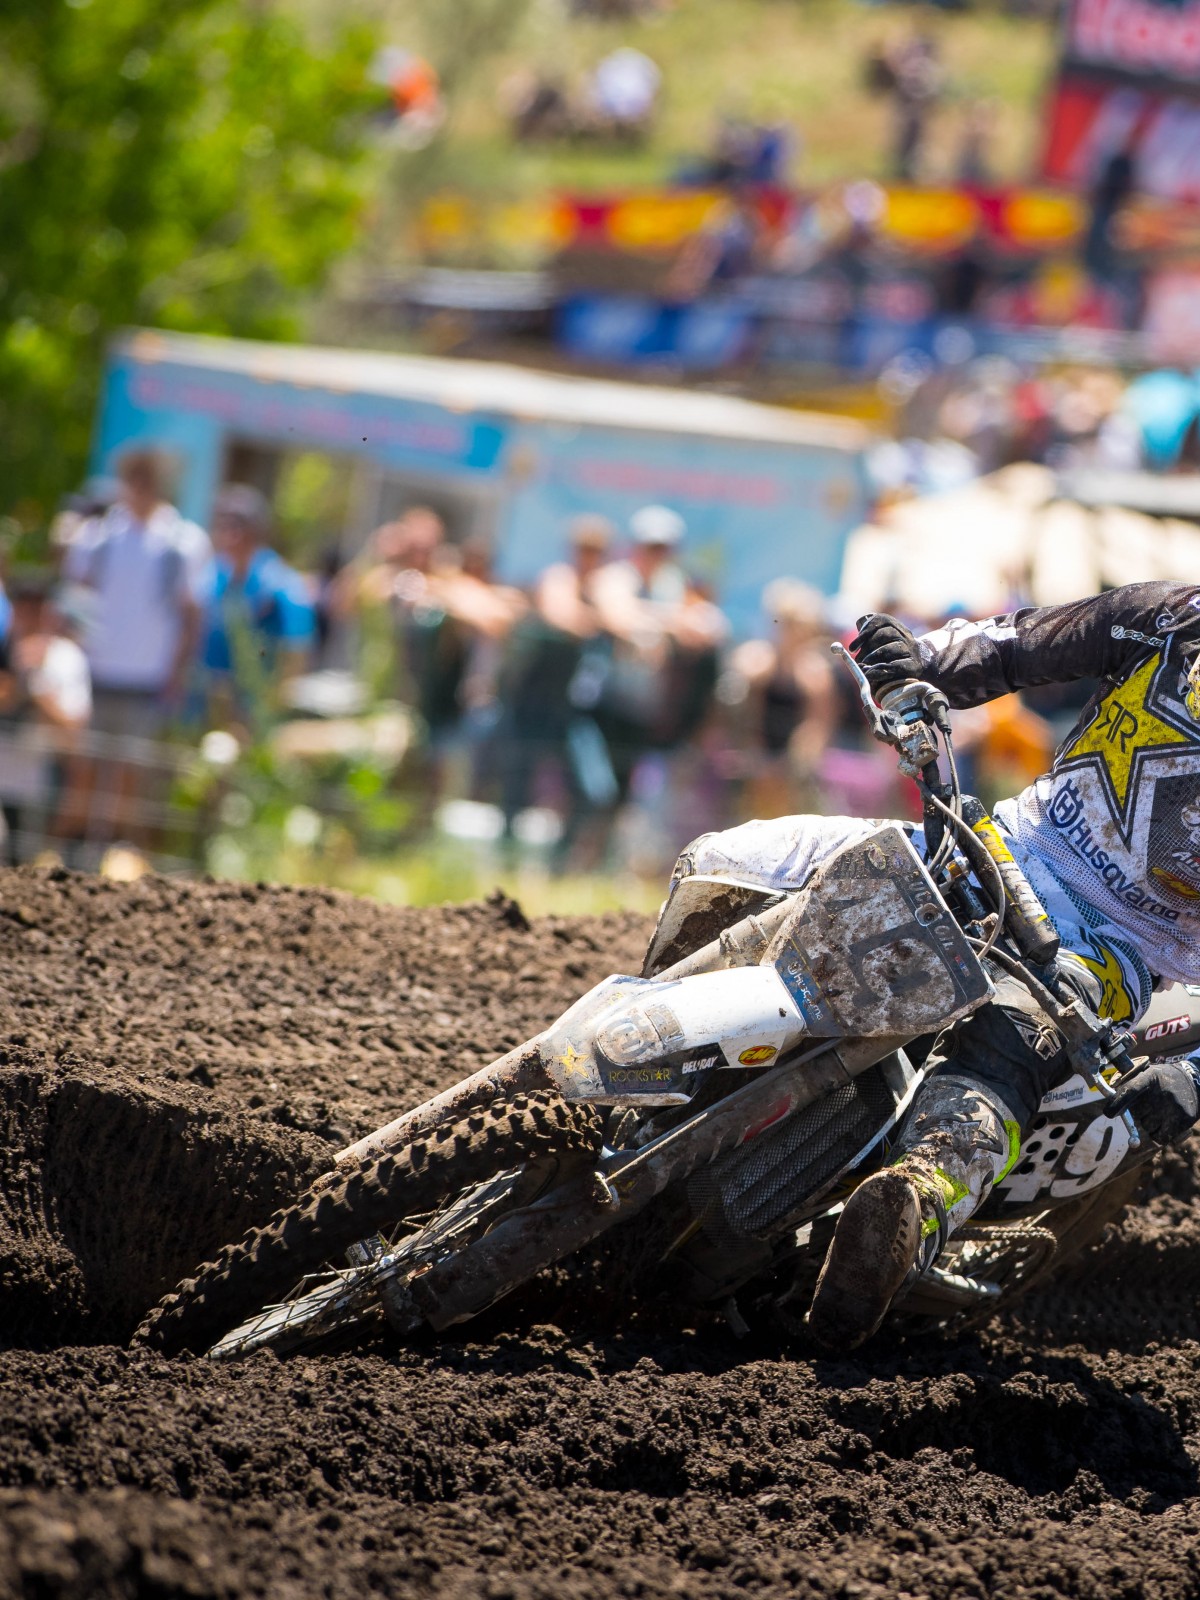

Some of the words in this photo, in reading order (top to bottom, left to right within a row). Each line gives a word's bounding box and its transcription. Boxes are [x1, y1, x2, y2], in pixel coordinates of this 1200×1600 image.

[1069, 818, 1181, 922] Husqvarna
[1144, 1015, 1191, 1041] GUTS
[739, 1045, 777, 1065] FMF
[1051, 1086, 1085, 1101] Husqvarna
[996, 1114, 1131, 1202] 49
